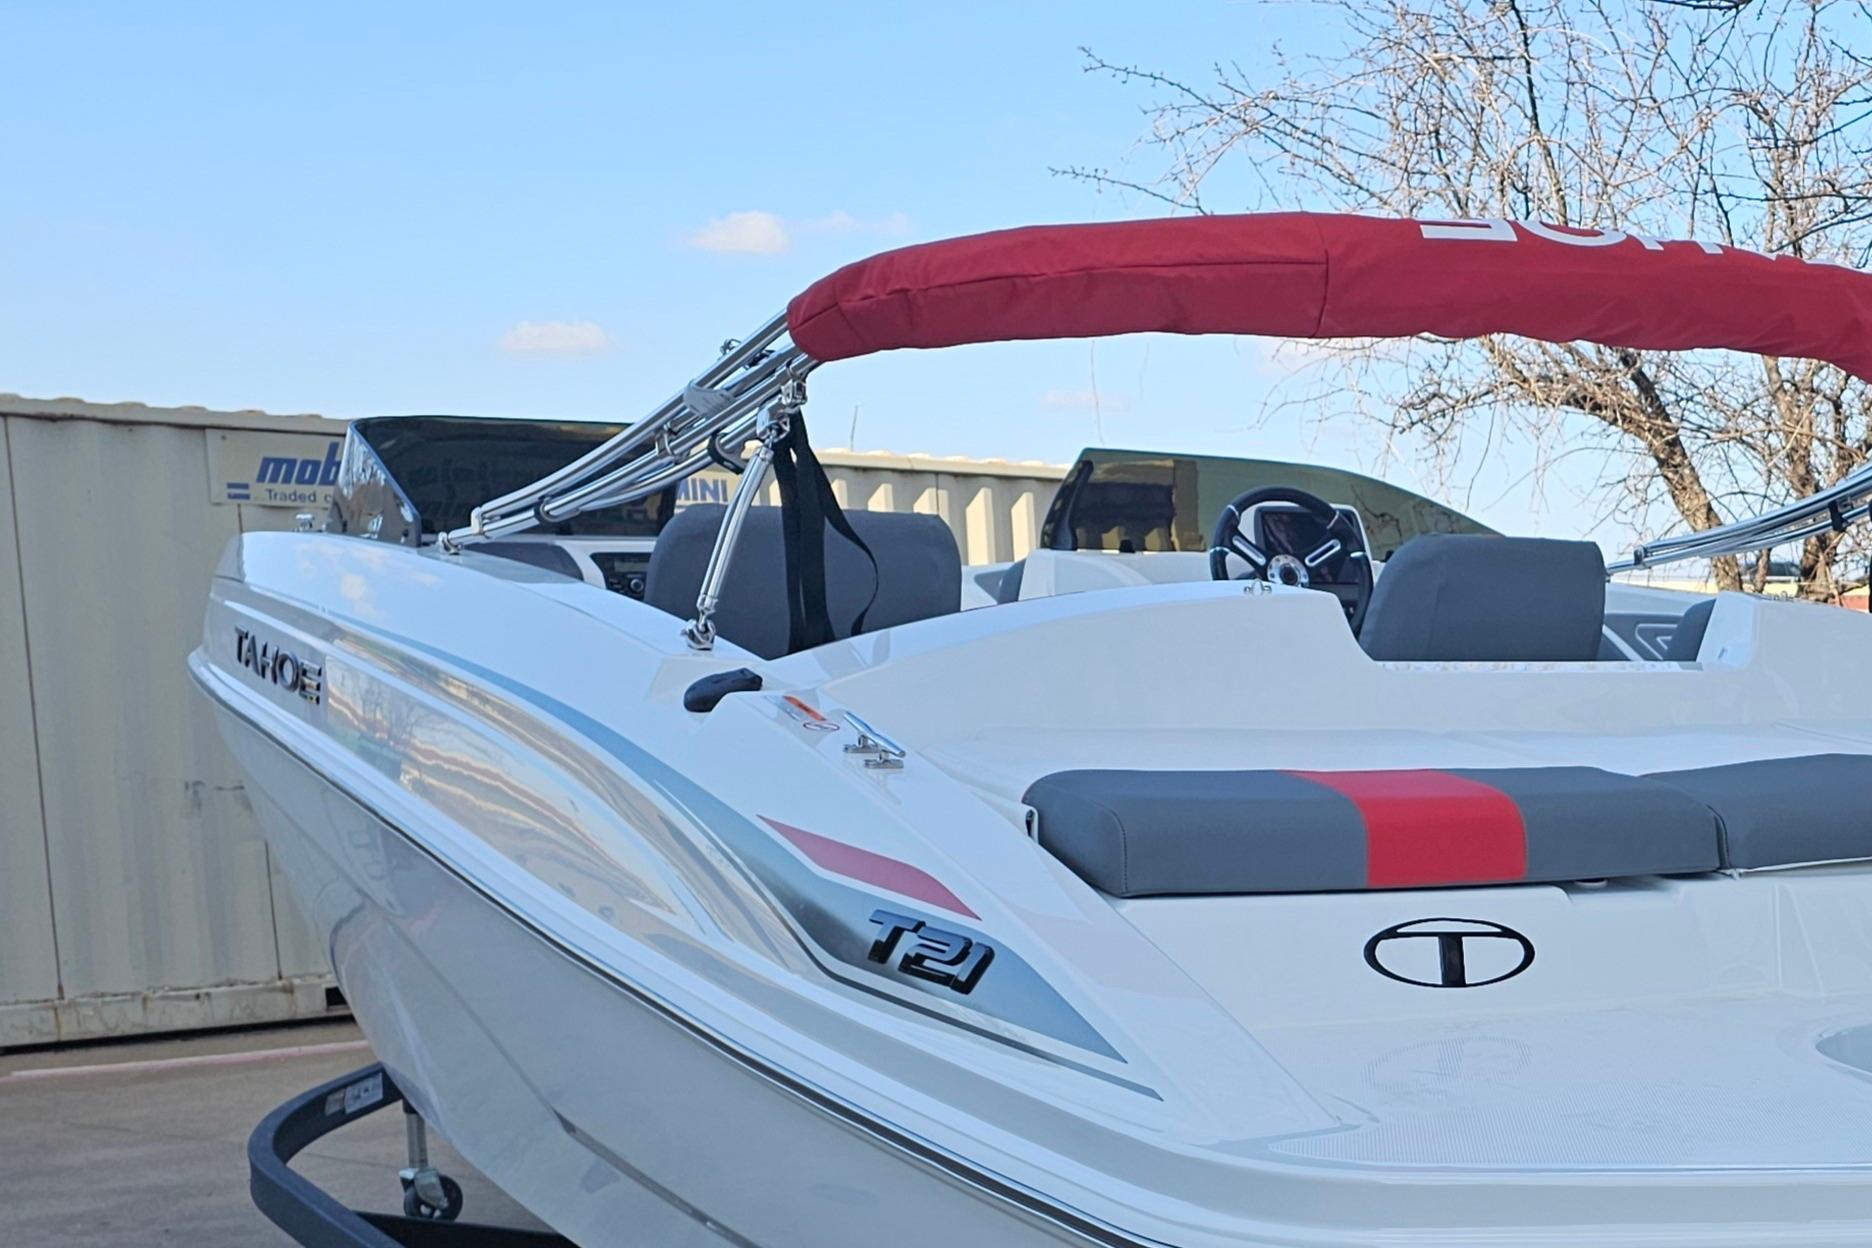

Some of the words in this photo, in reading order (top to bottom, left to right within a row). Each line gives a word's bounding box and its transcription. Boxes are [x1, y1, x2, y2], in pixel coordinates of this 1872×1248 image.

[265, 488, 317, 503] Traded
[235, 626, 322, 705] TAHOE
[868, 909, 995, 996] T21
